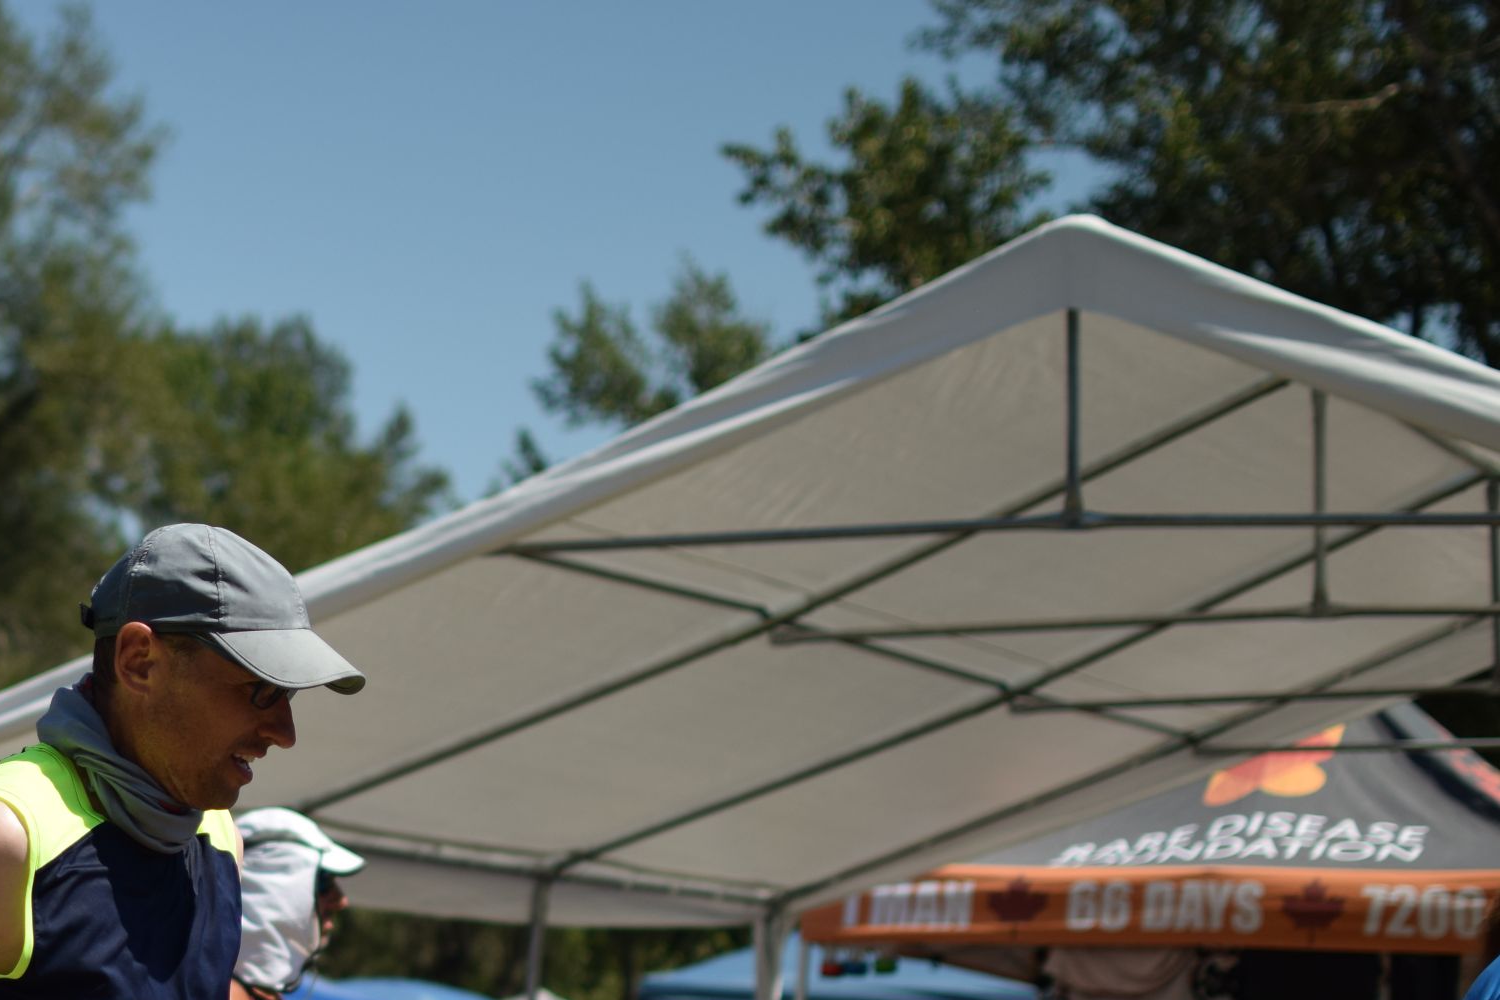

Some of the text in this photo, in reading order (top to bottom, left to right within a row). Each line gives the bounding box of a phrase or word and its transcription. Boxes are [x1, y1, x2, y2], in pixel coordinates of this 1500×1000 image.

[1206, 810, 1431, 847] DISEASE
[1065, 880, 1133, 932] 66
[1140, 880, 1266, 934] DAYS
[1360, 884, 1487, 940] 7200
